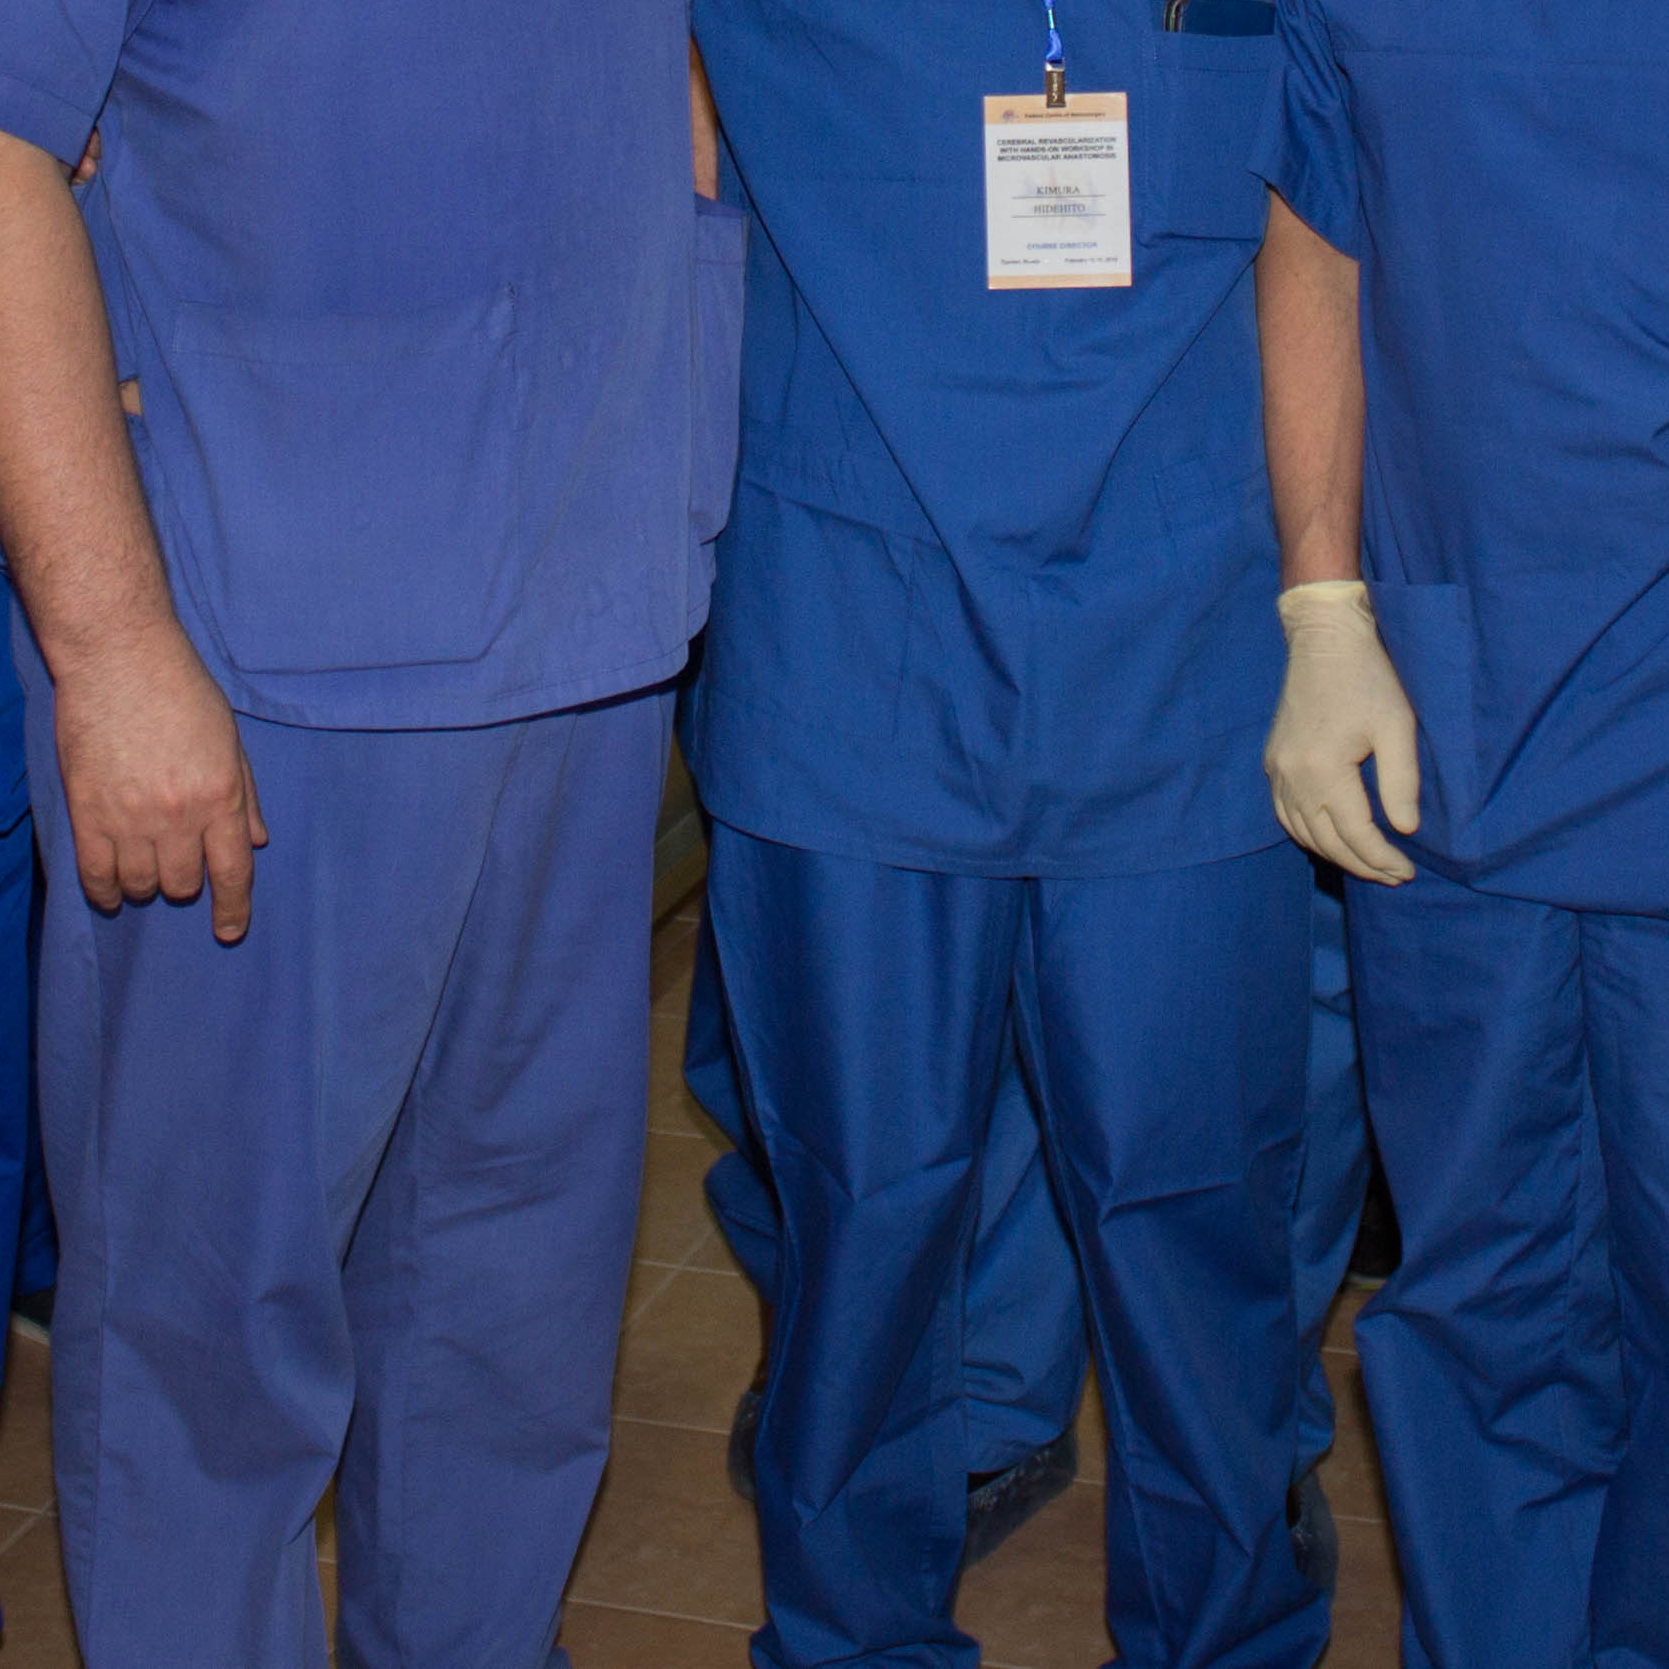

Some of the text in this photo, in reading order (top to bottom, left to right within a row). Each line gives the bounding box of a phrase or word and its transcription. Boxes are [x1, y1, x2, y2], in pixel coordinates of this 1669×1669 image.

[996, 137, 1117, 146] CEREBRAL REVASCULARIZATION
[1061, 145, 1105, 153] WORKSHOP
[997, 153, 1117, 162] MICROVASCULAR ANASTOMOSIS
[1036, 186, 1080, 195] KIMURA
[1033, 204, 1086, 214] HIDEHITO
